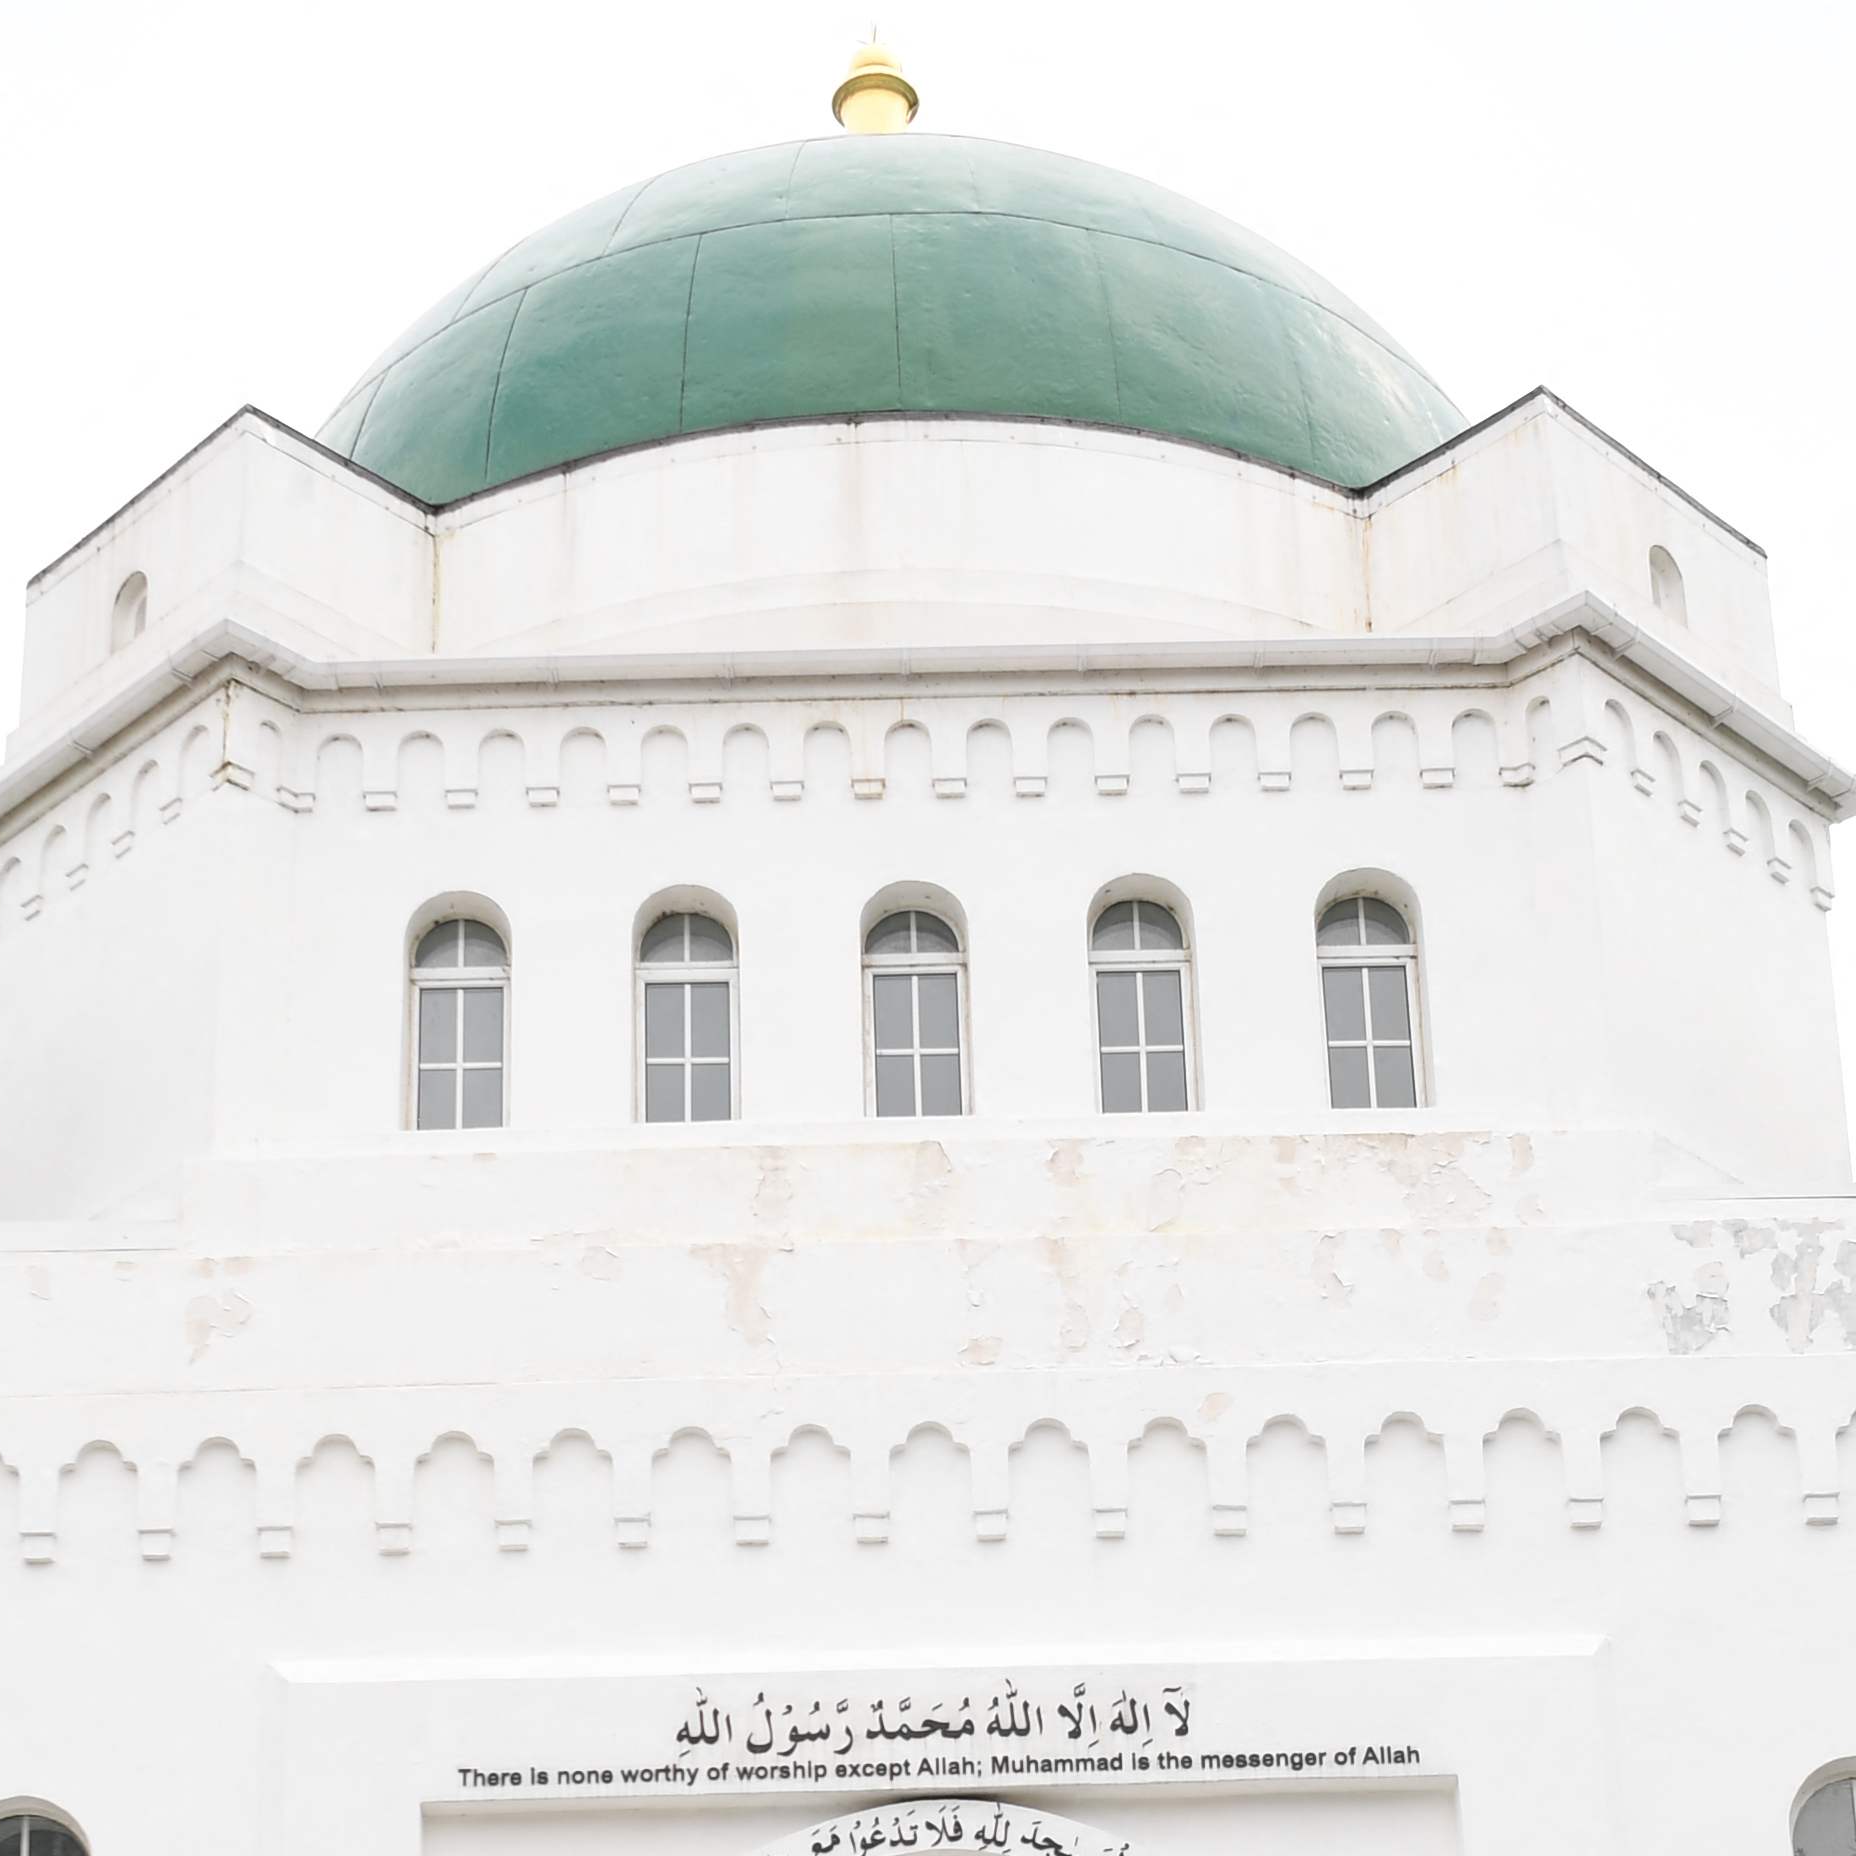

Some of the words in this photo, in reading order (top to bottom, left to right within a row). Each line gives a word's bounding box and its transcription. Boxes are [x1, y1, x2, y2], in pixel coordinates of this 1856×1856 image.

[458, 1768, 522, 1787] There
[530, 1767, 549, 1785] is
[557, 1769, 614, 1785] none
[620, 1763, 699, 1787] worthy
[706, 1762, 730, 1781] of
[735, 1760, 827, 1783] worship
[835, 1759, 911, 1782] except
[917, 1756, 983, 1777] Allah;
[991, 1752, 1123, 1775] Muhammad
[1131, 1752, 1150, 1771] is
[1157, 1751, 1193, 1770] the
[1200, 1751, 1327, 1771] messenger
[1334, 1746, 1357, 1766] of
[1362, 1745, 1420, 1765] Allah
